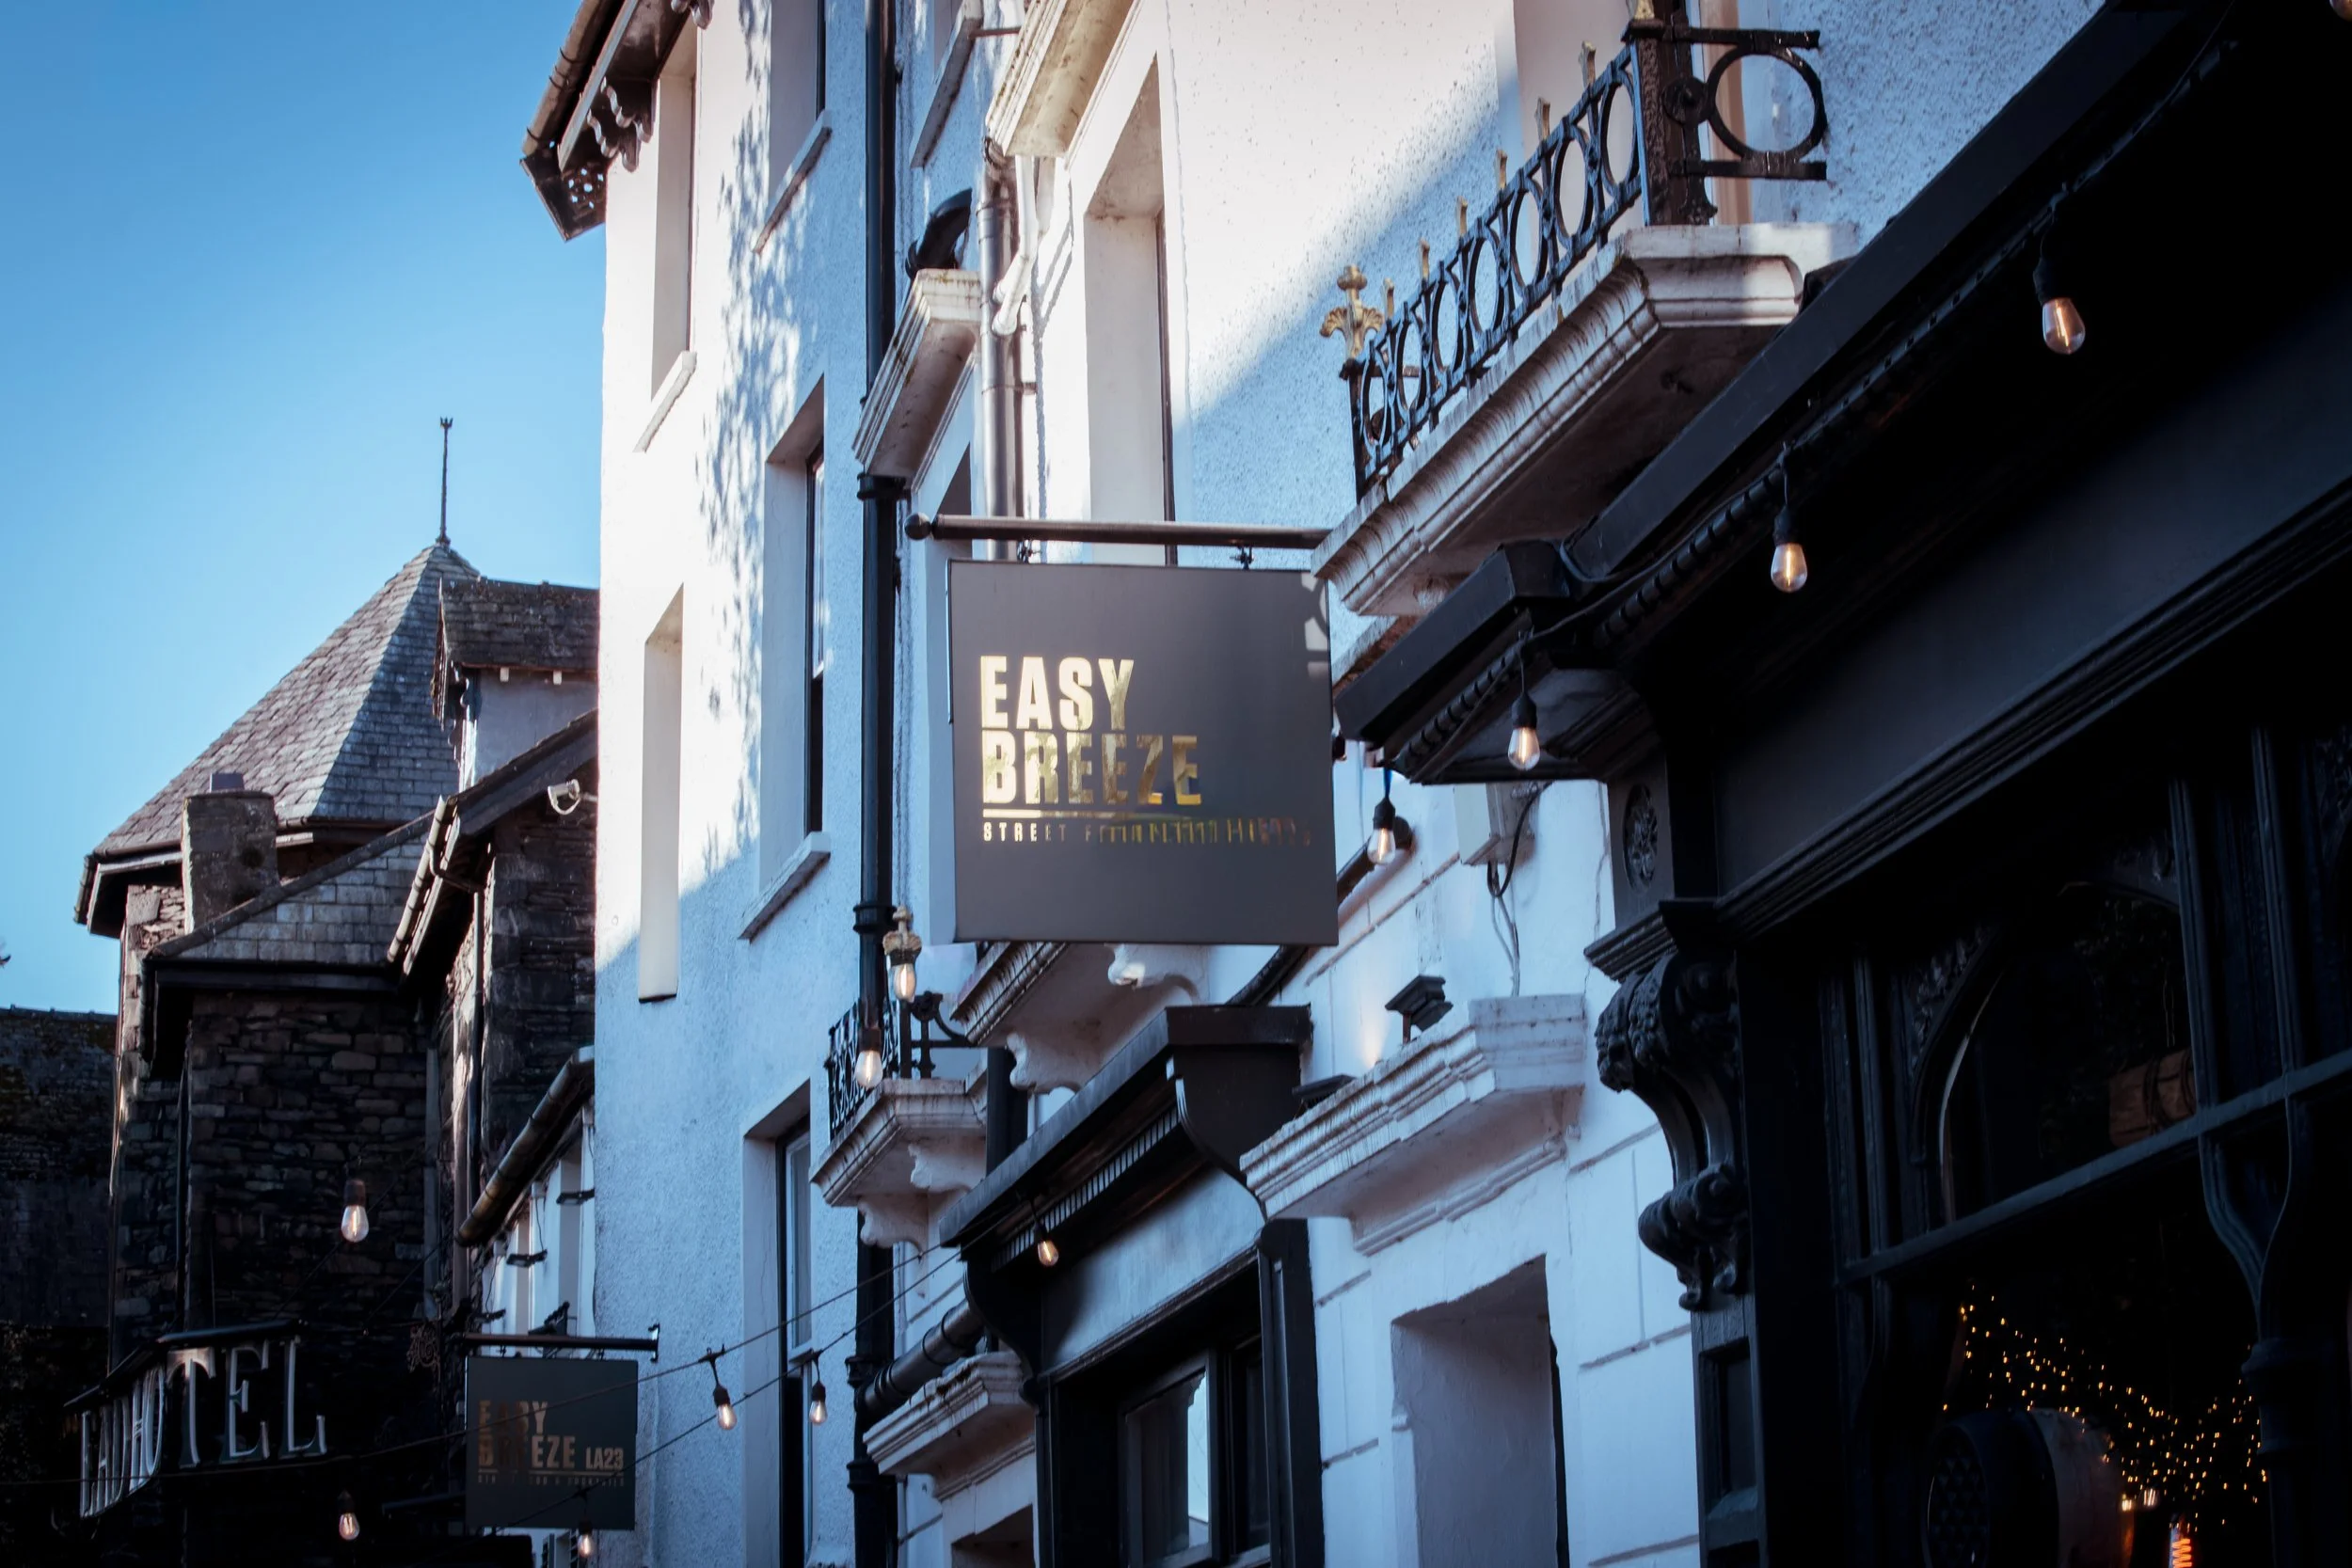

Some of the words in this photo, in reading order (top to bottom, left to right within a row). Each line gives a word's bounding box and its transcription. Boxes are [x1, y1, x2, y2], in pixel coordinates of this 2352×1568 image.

[980, 656, 1135, 731] EASY
[982, 730, 1202, 806] BREEZE
[983, 822, 1067, 844] STREET
[128, 1335, 328, 1496] HOTEL
[585, 1447, 624, 1470] LA23
